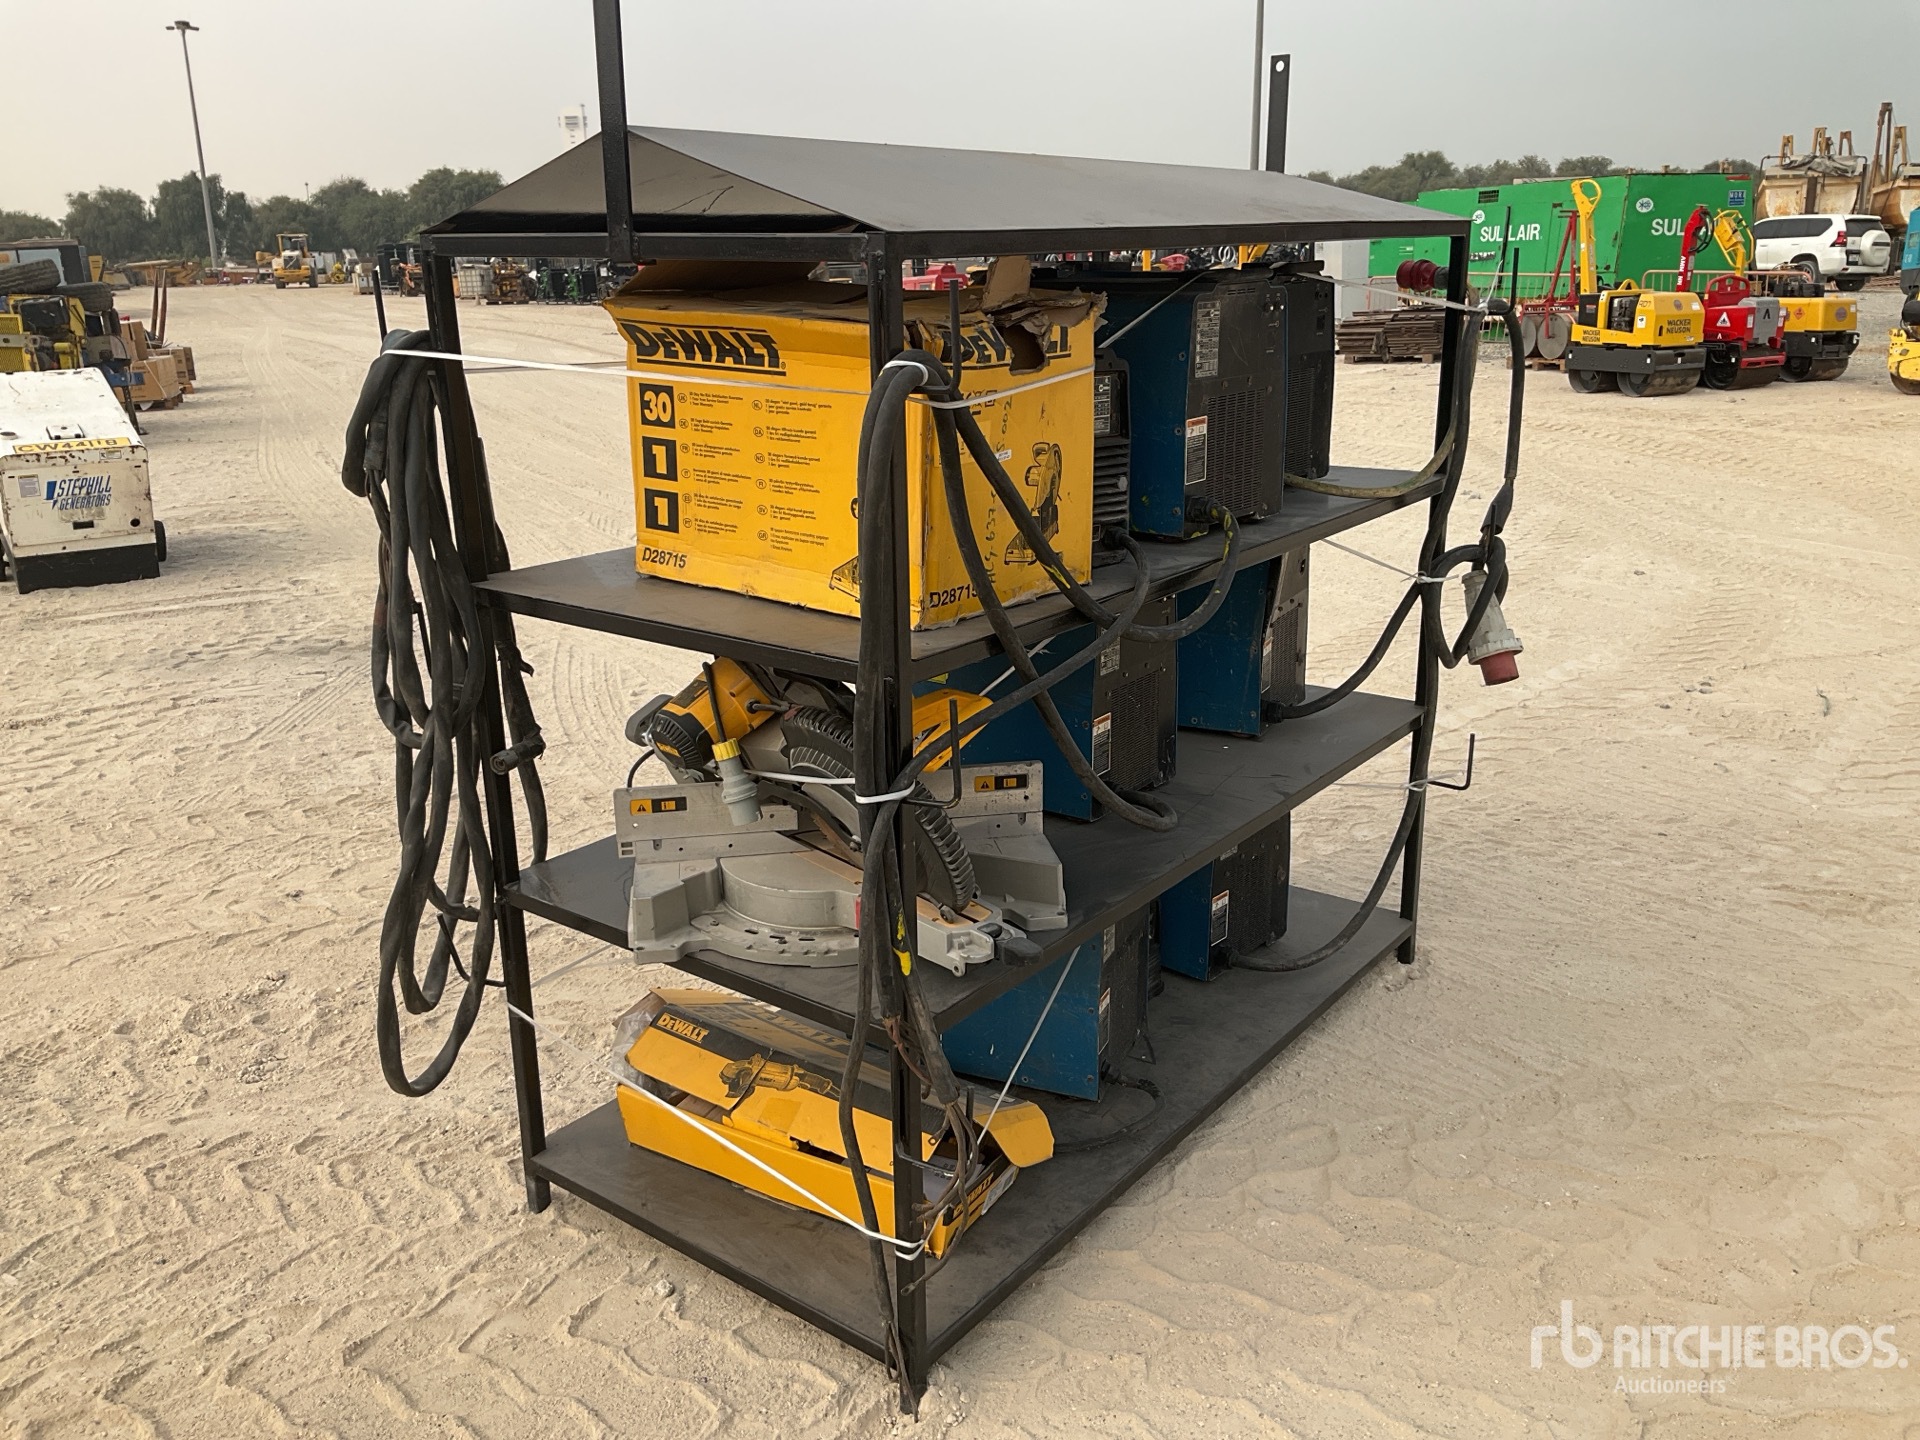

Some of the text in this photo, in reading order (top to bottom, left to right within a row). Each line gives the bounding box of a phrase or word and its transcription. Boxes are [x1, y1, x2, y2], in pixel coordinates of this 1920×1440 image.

[1480, 223, 1540, 242] SULLAIR
[1666, 326, 1691, 334] NEUSON
[1667, 318, 1691, 326] WACKER
[644, 390, 672, 423] 30
[652, 444, 668, 475] 1
[57, 475, 111, 498] STEPHILL
[59, 493, 111, 511] GENERATORS
[654, 496, 669, 527] 1
[642, 547, 687, 568] D28715
